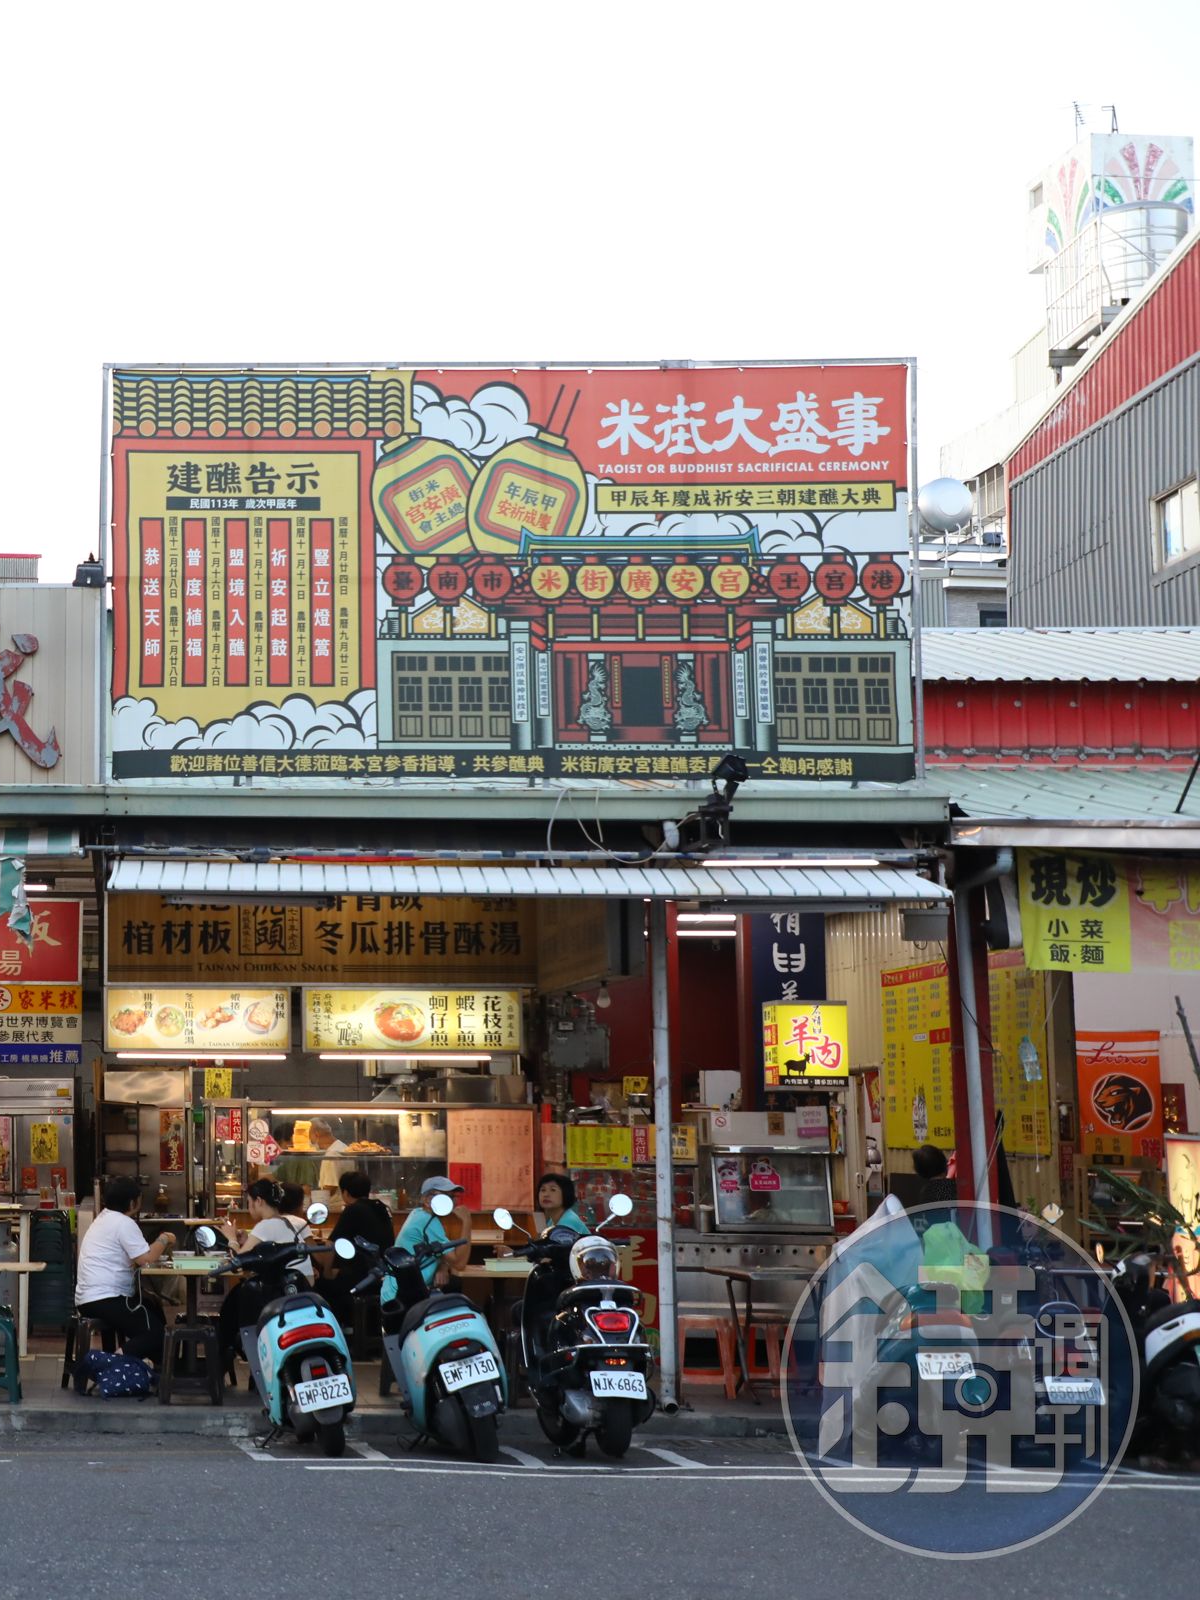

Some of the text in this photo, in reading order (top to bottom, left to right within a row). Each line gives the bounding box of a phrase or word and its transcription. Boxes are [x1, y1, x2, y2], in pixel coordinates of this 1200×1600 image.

[597, 391, 891, 457] 米街大盛事
[166, 461, 320, 494] 建醮告示
[598, 461, 889, 474] TAOIST OR BUDDHIST SACRIFICIAL CEREMONY
[189, 498, 298, 510] 民國113年 歲次甲辰年
[611, 488, 881, 507] 甲辰年慶成祈安三朝建醮大典
[393, 569, 503, 593] 臺南市
[537, 568, 746, 594] 米街廣安宮
[779, 569, 894, 593] 王宮港
[144, 548, 160, 656] 恭送天師
[186, 548, 202, 656] 普度植福
[271, 548, 287, 656] 祈安起鼓
[561, 756, 853, 776] 米街廣安宮建醮委員一仝鞠躬感謝
[1029, 856, 1116, 907] 現炒
[121, 920, 231, 956] 棺材板
[315, 921, 521, 956] 冬瓜排骨酥湯
[1047, 919, 1103, 939] 小菜
[429, 996, 448, 1047] 蚵仔煎
[456, 996, 475, 1047] 蝦仁煎
[483, 996, 502, 1047] 花枝煎
[49, 1049, 79, 1063] 推薦
[784, 1016, 841, 1069] 羊肉
[1085, 1041, 1148, 1065] Lions
